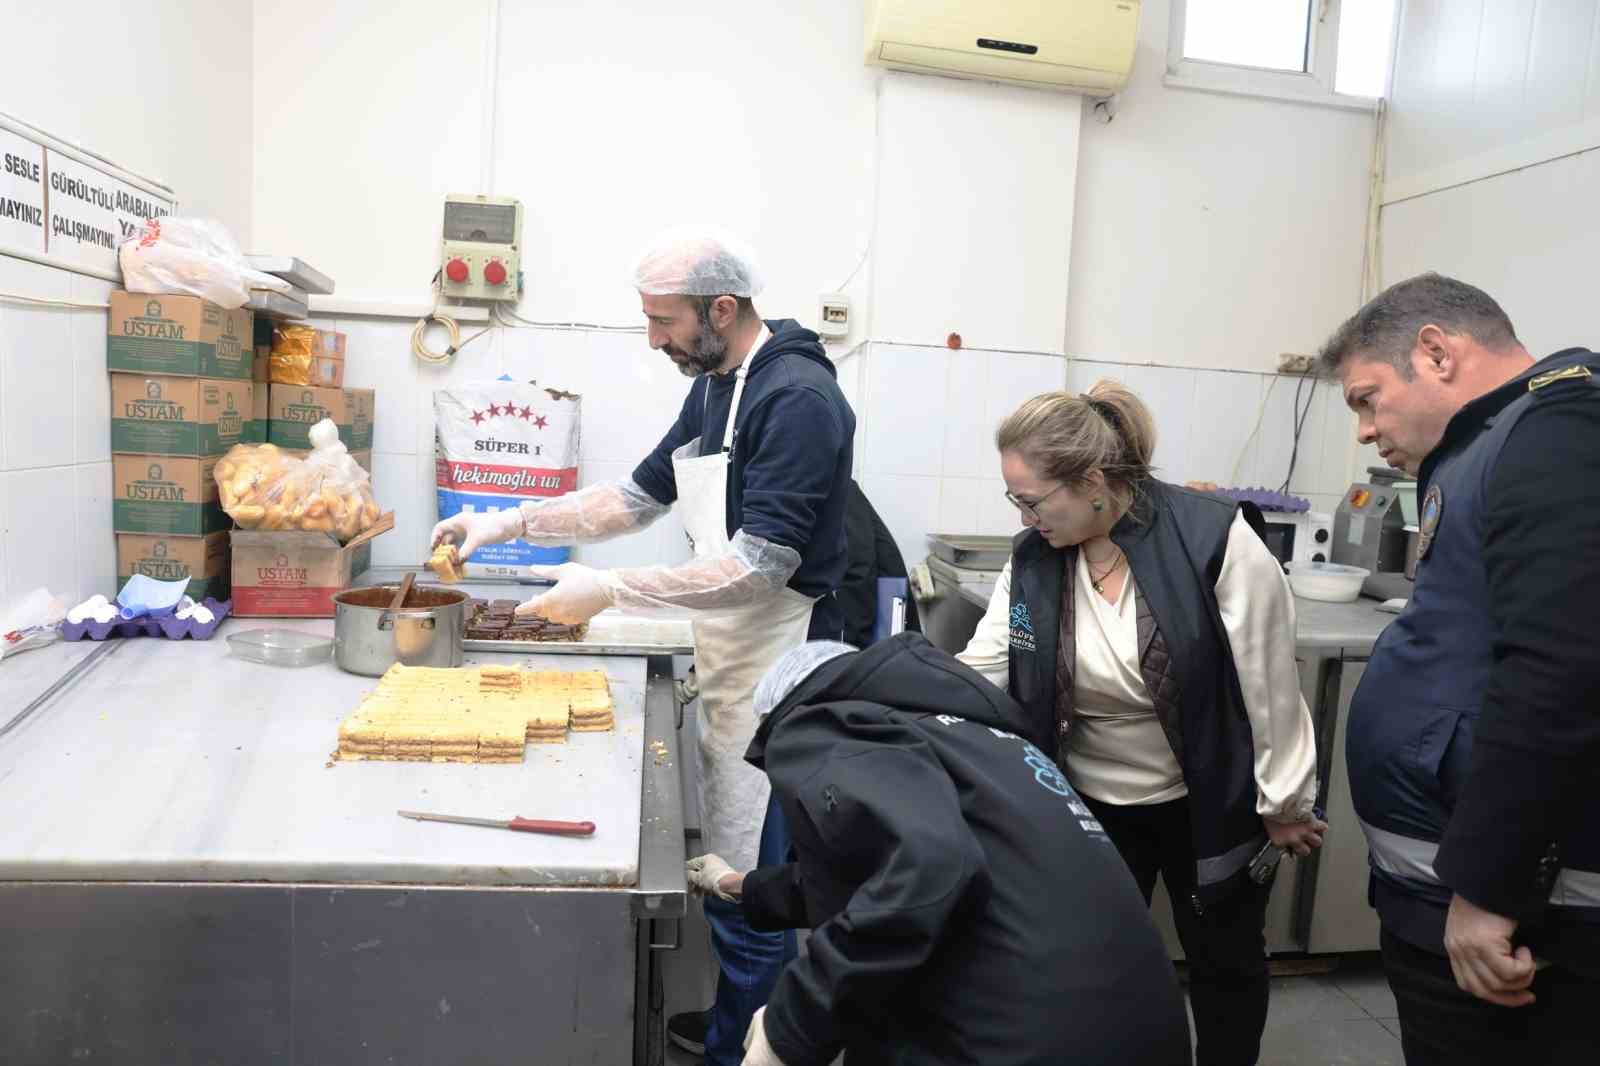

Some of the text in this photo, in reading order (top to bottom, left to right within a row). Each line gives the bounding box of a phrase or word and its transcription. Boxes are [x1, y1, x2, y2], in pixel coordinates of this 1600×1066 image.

[5, 153, 40, 183] SESLE
[53, 215, 114, 249] ÇALIŞMAYINI
[123, 320, 185, 340] USTAM
[125, 403, 185, 421] USTAM
[474, 437, 530, 456] SÜPER
[452, 463, 560, 491] hekimoğlu un
[126, 483, 185, 501] USTAM
[130, 561, 191, 579] USTAM
[257, 567, 307, 580] USTAM
